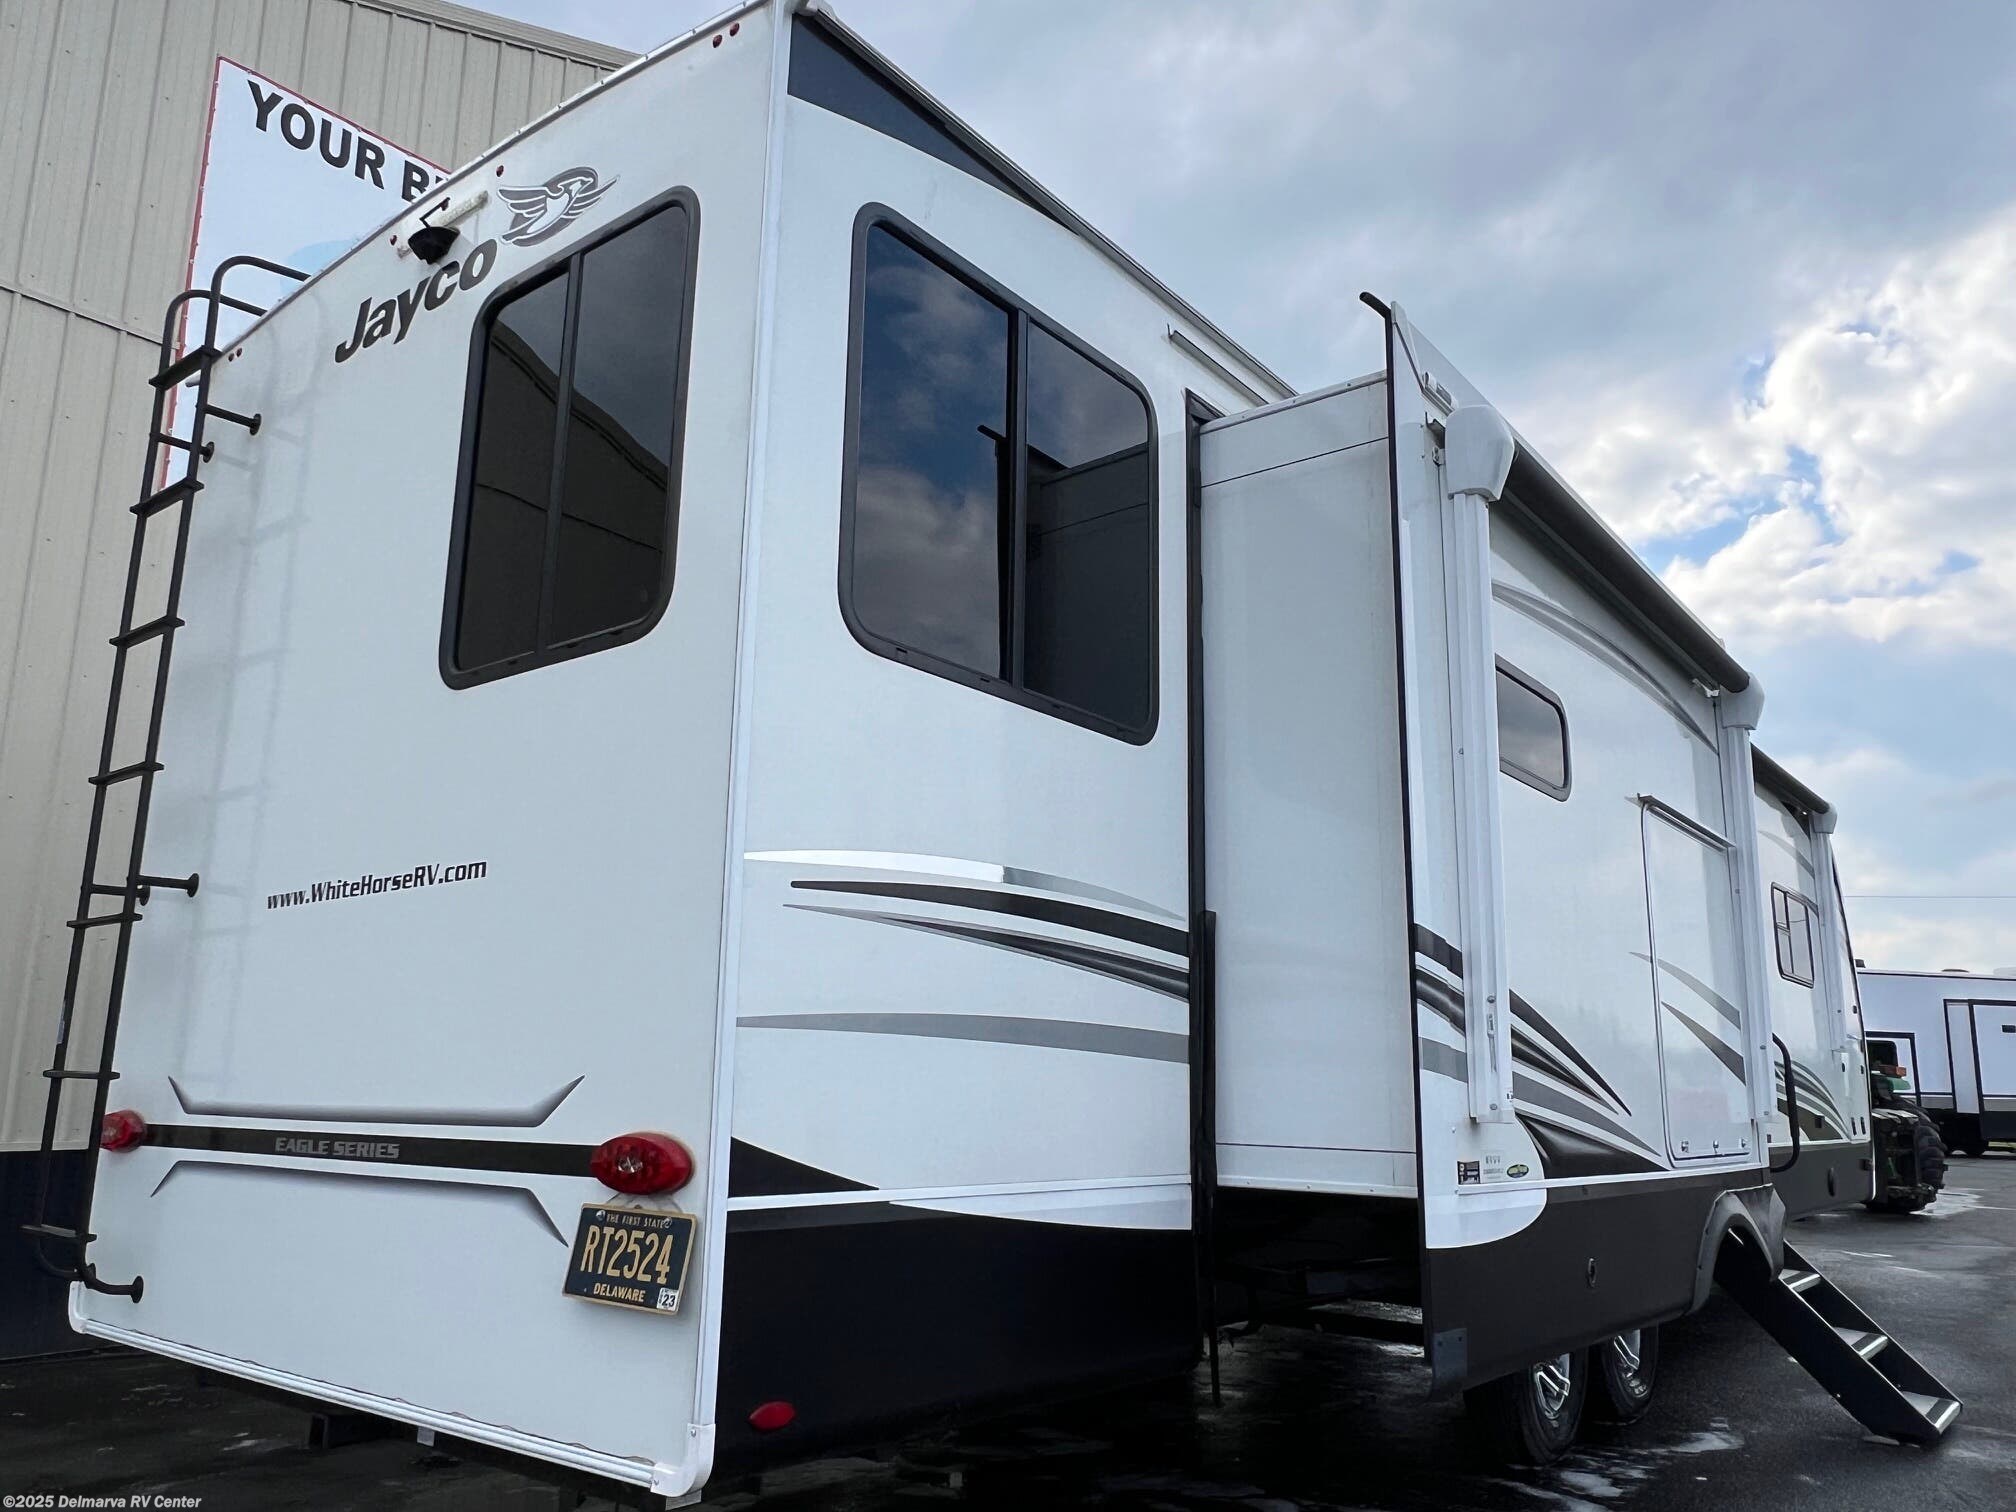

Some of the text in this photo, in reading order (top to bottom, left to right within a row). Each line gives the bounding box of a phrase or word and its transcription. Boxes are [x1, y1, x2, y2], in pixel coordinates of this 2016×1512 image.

[247, 79, 444, 202] YOUR B
[334, 238, 498, 363] Jayco
[267, 861, 487, 909] www.WhiteHorseRV.com
[274, 1137, 400, 1159] EAGLE SERIES
[606, 1213, 620, 1224] THE
[621, 1215, 641, 1226] FIRST
[580, 1225, 674, 1285] RT2524
[593, 1282, 646, 1302] DELAWARE
[661, 1294, 676, 1307] 23
